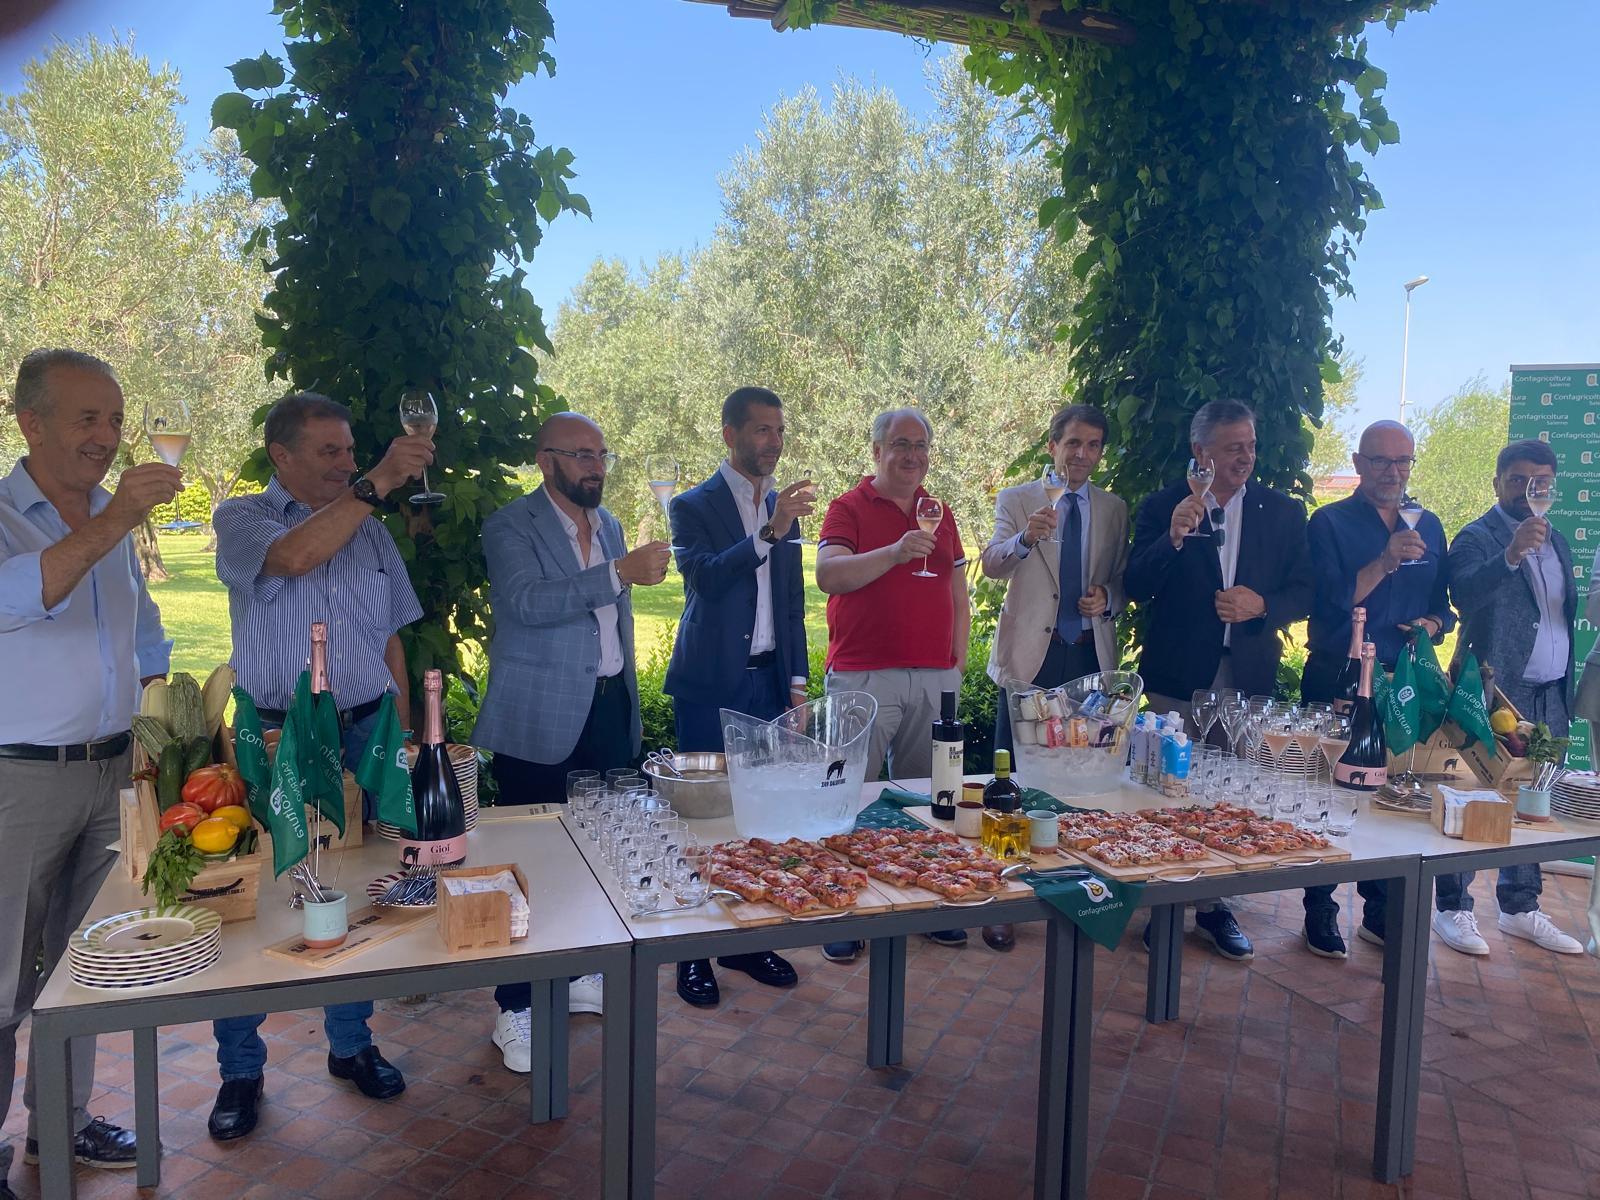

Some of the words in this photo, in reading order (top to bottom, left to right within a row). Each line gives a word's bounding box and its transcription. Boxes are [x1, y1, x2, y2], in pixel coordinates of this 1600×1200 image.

[1514, 375, 1572, 385] Confagricoltura
[1553, 393, 1600, 402] Confagricolt
[1512, 412, 1569, 422] Confagricoltura
[1551, 431, 1600, 440] Confagricoltu
[1078, 901, 1124, 917] Confagricoltura
